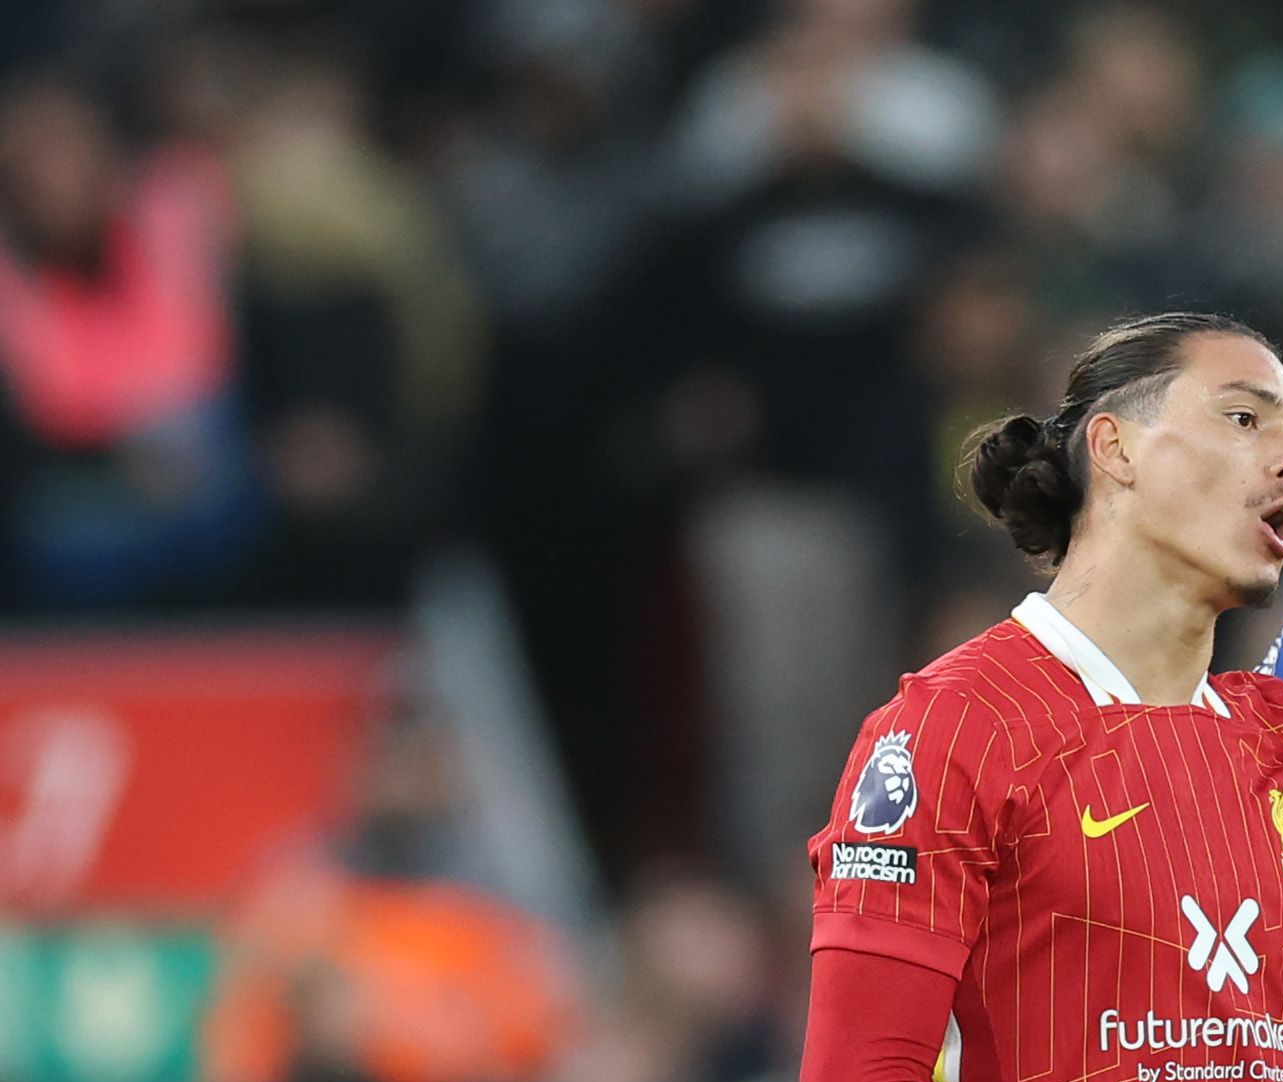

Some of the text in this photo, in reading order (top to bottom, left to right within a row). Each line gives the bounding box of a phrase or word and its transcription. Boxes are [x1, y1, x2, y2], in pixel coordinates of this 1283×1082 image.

[831, 843, 908, 867] No room
[850, 863, 916, 885] racism
[1165, 1060, 1244, 1081] Standard
